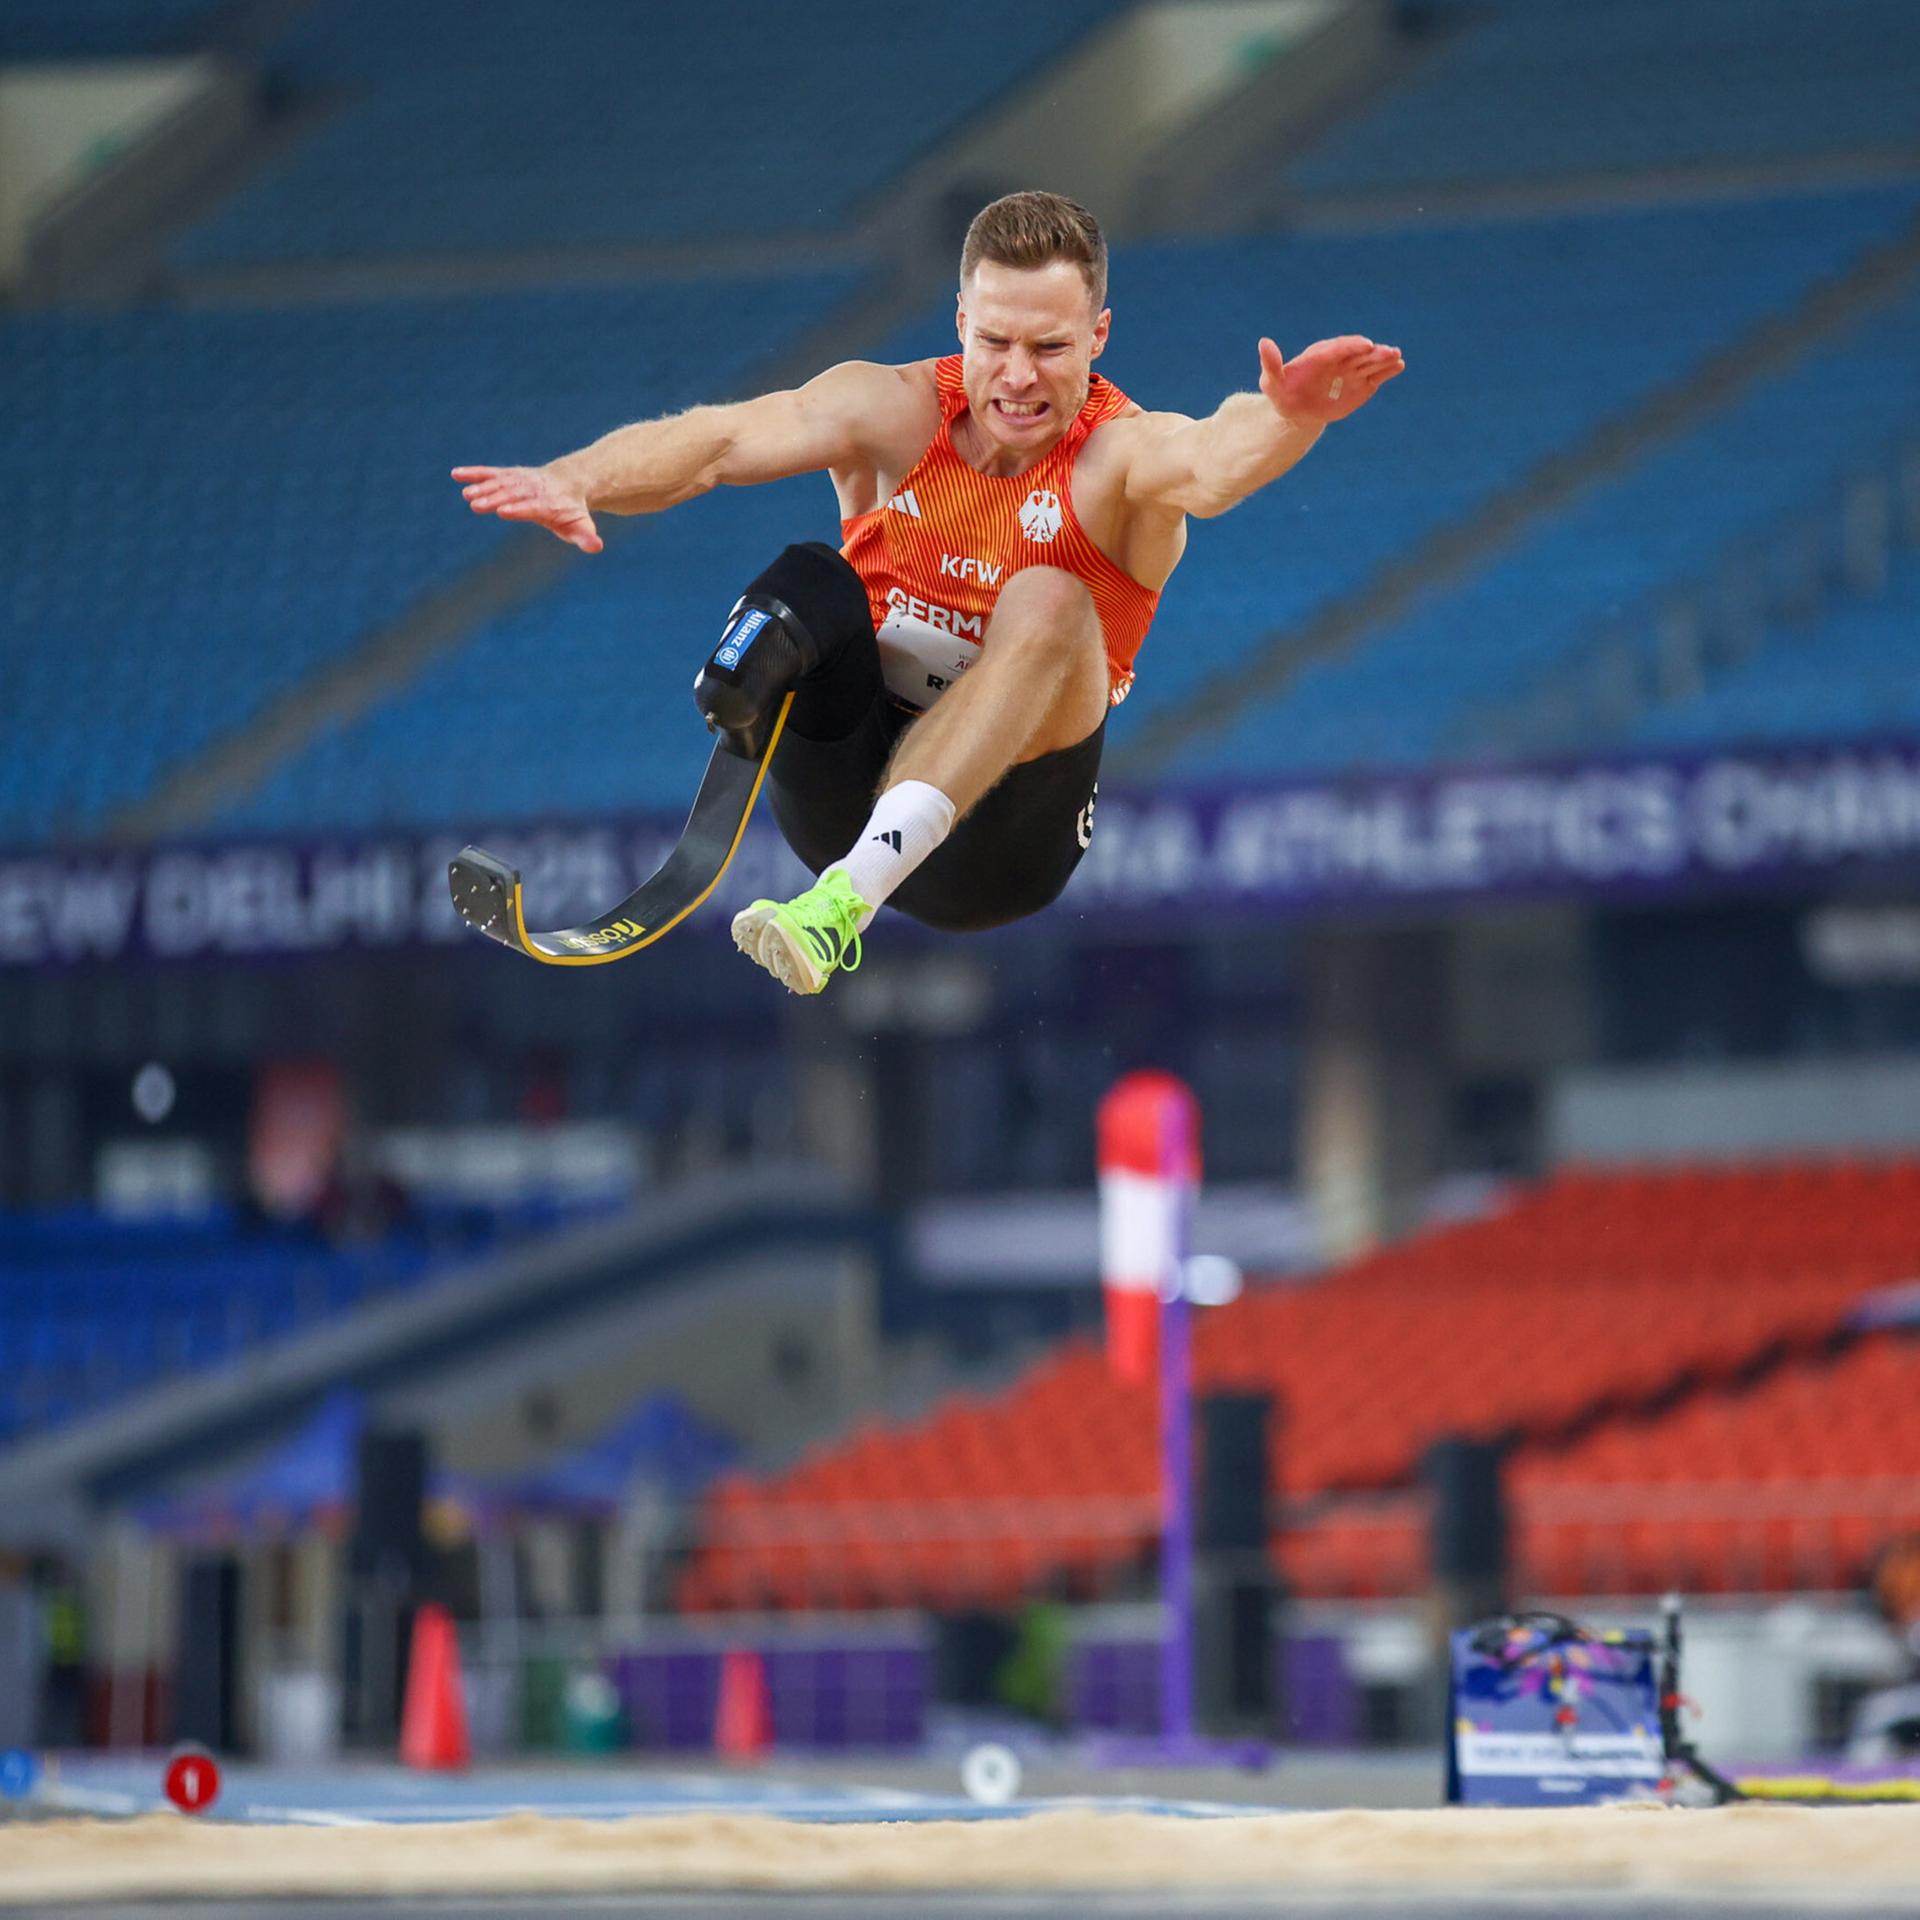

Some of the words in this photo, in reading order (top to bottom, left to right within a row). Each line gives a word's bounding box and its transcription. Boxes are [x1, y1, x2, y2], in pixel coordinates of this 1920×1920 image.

[940, 553, 1003, 585] KFW
[731, 610, 766, 648] Allianz
[886, 587, 982, 639] GERM
[143, 842, 398, 957] DELHI
[1215, 763, 1680, 893] ATHLETICS
